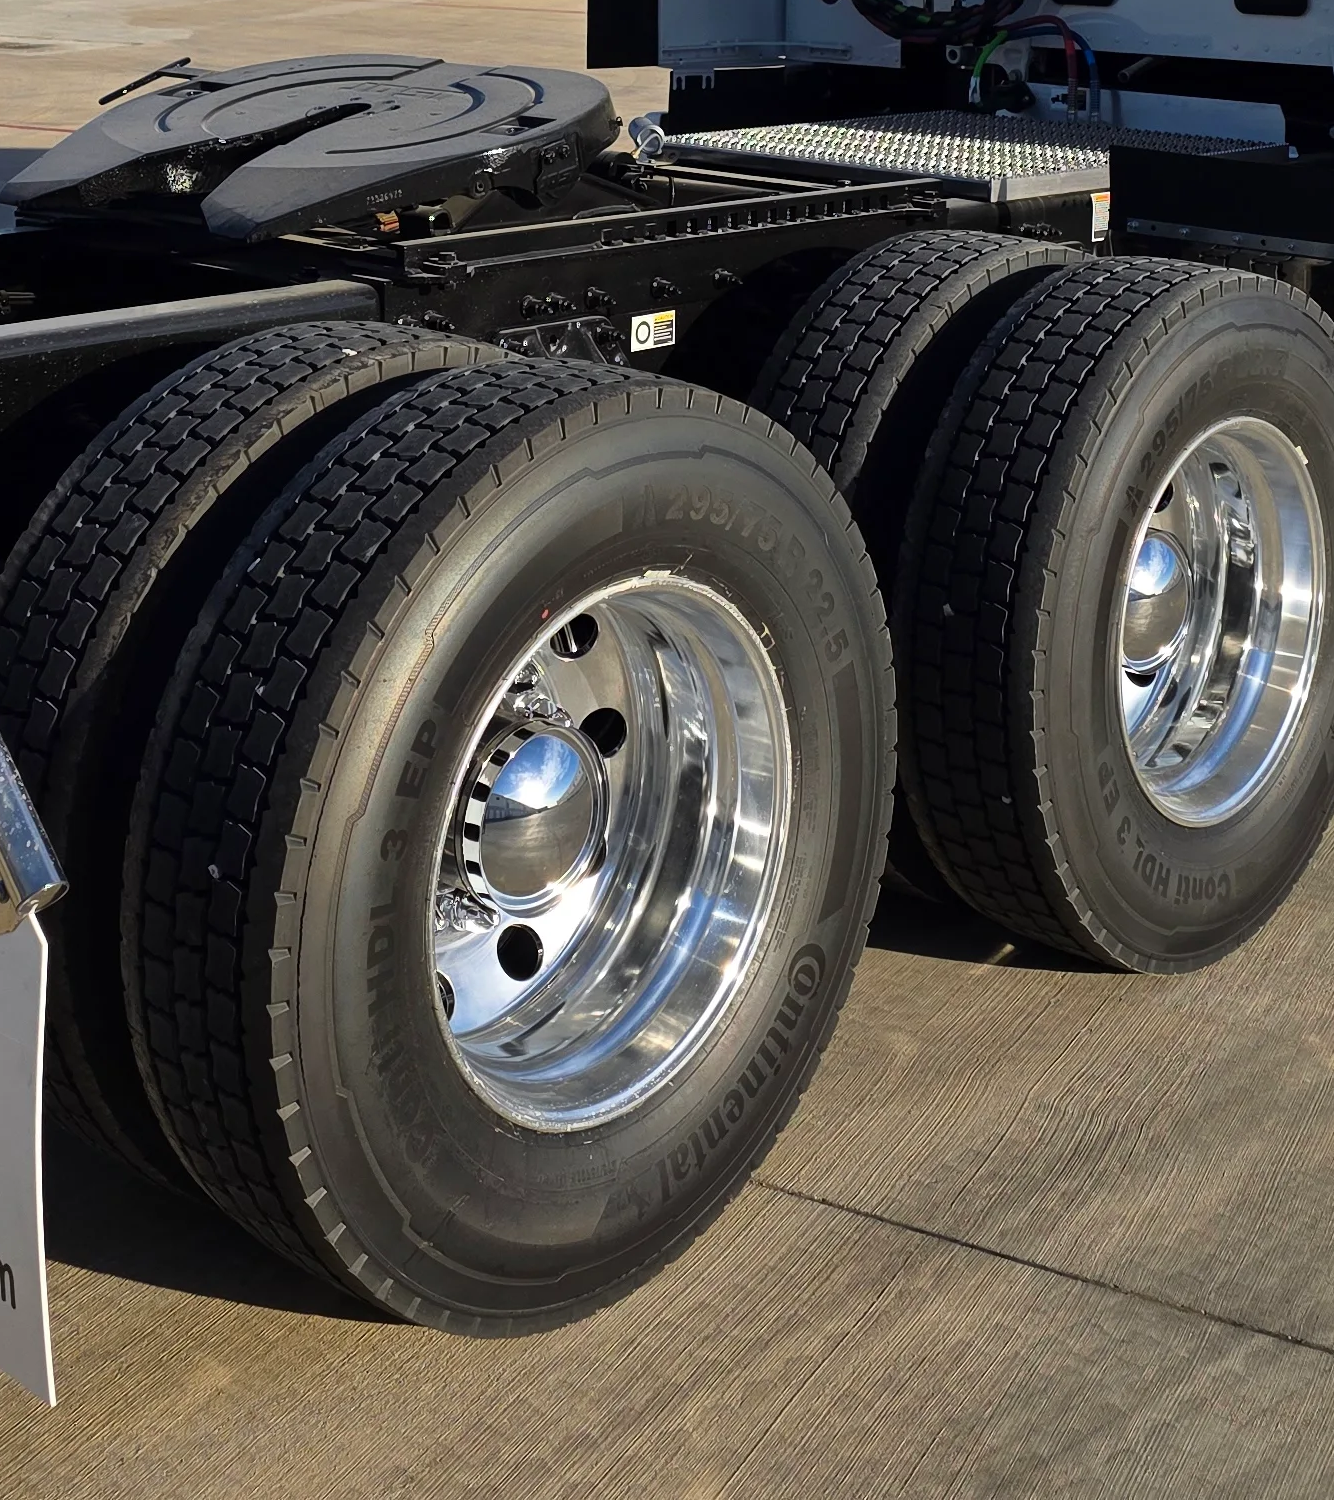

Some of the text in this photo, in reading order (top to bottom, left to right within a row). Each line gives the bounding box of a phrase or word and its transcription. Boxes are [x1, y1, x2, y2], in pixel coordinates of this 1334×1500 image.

[665, 485, 783, 551] 295/75
[395, 718, 441, 800] EP
[381, 828, 410, 862] 3
[1098, 761, 1232, 906] Conti HDL 3 EP
[365, 885, 405, 1017] HDL
[653, 944, 826, 1205] Continental
